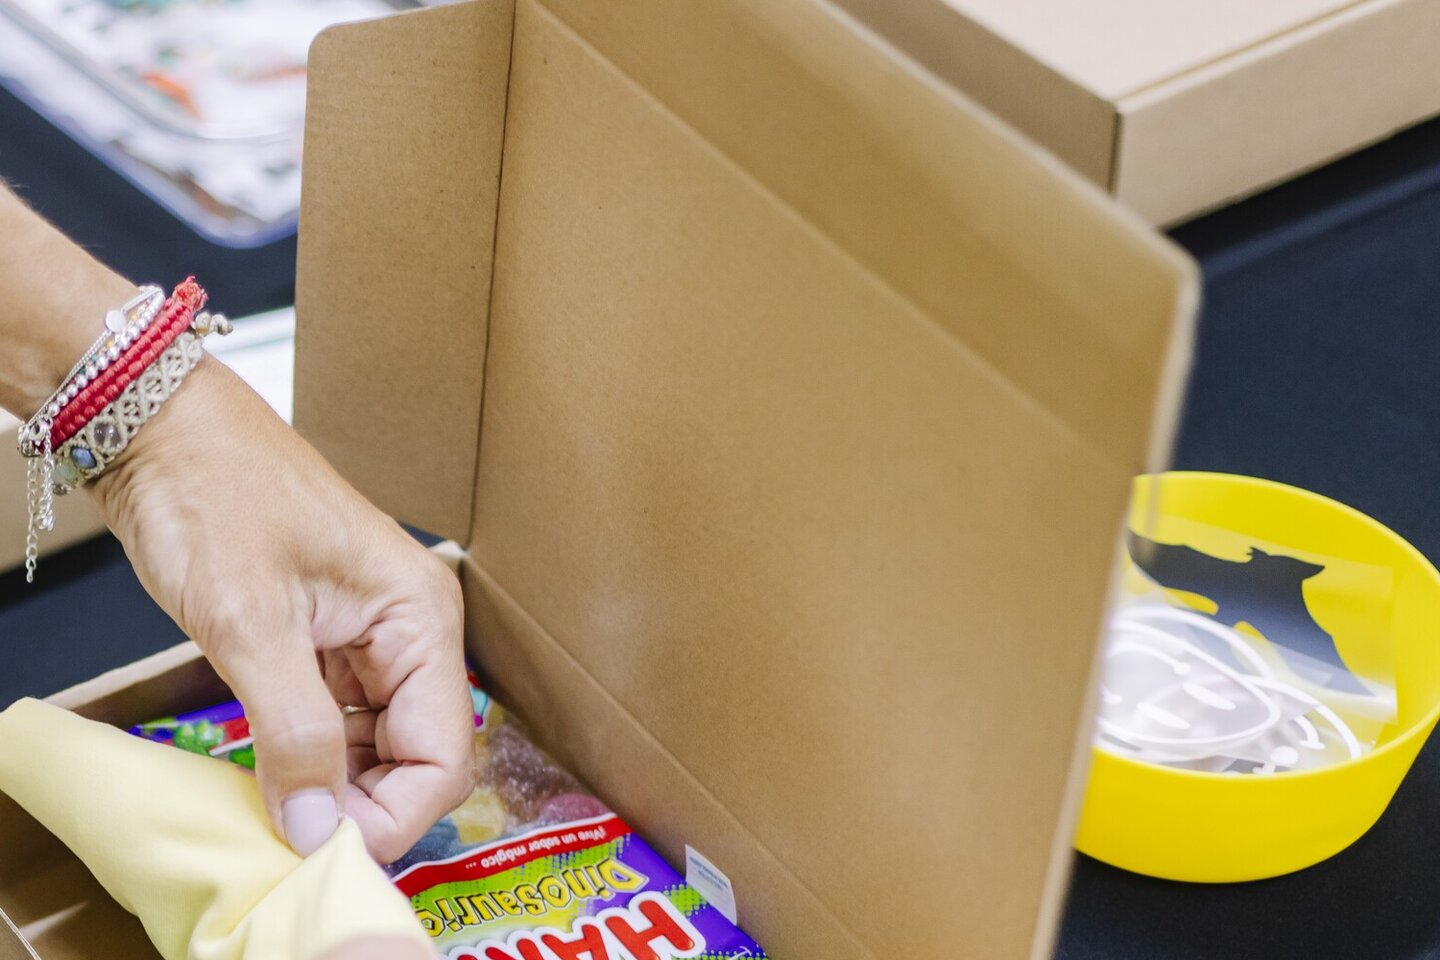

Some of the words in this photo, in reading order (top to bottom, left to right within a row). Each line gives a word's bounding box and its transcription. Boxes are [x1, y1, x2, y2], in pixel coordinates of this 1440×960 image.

[527, 836, 561, 854] sabor
[561, 832, 578, 844] un
[480, 847, 527, 870] mágico
